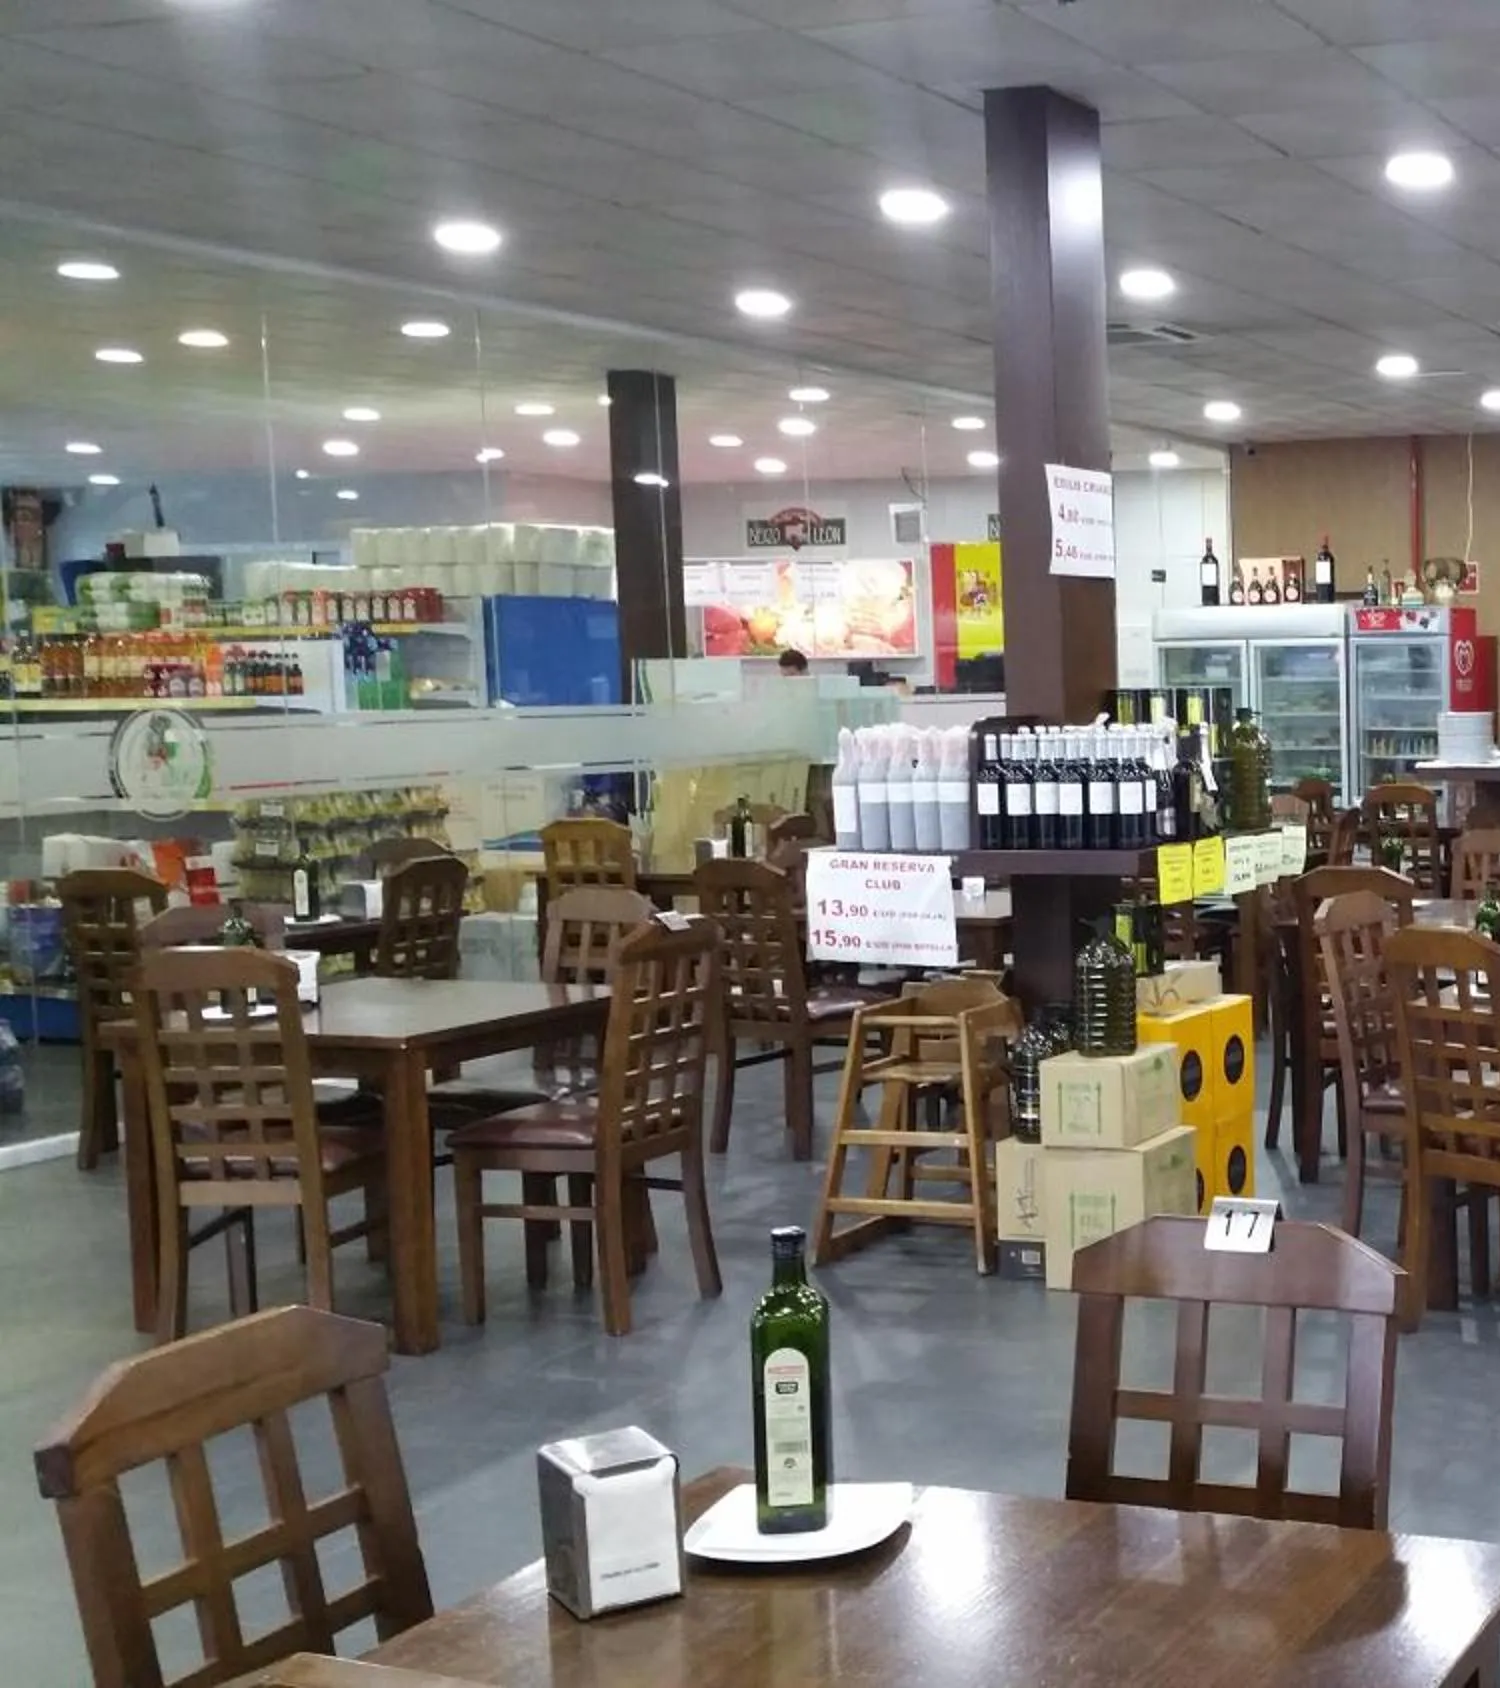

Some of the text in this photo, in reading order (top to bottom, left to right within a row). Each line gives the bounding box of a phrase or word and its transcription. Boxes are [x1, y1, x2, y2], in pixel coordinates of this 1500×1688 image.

[829, 859, 935, 873] GRAN RESERVA
[865, 878, 901, 890] CLUB
[817, 899, 868, 918] 13,90
[812, 929, 861, 948] 15,90
[1225, 1209, 1260, 1239] 17
